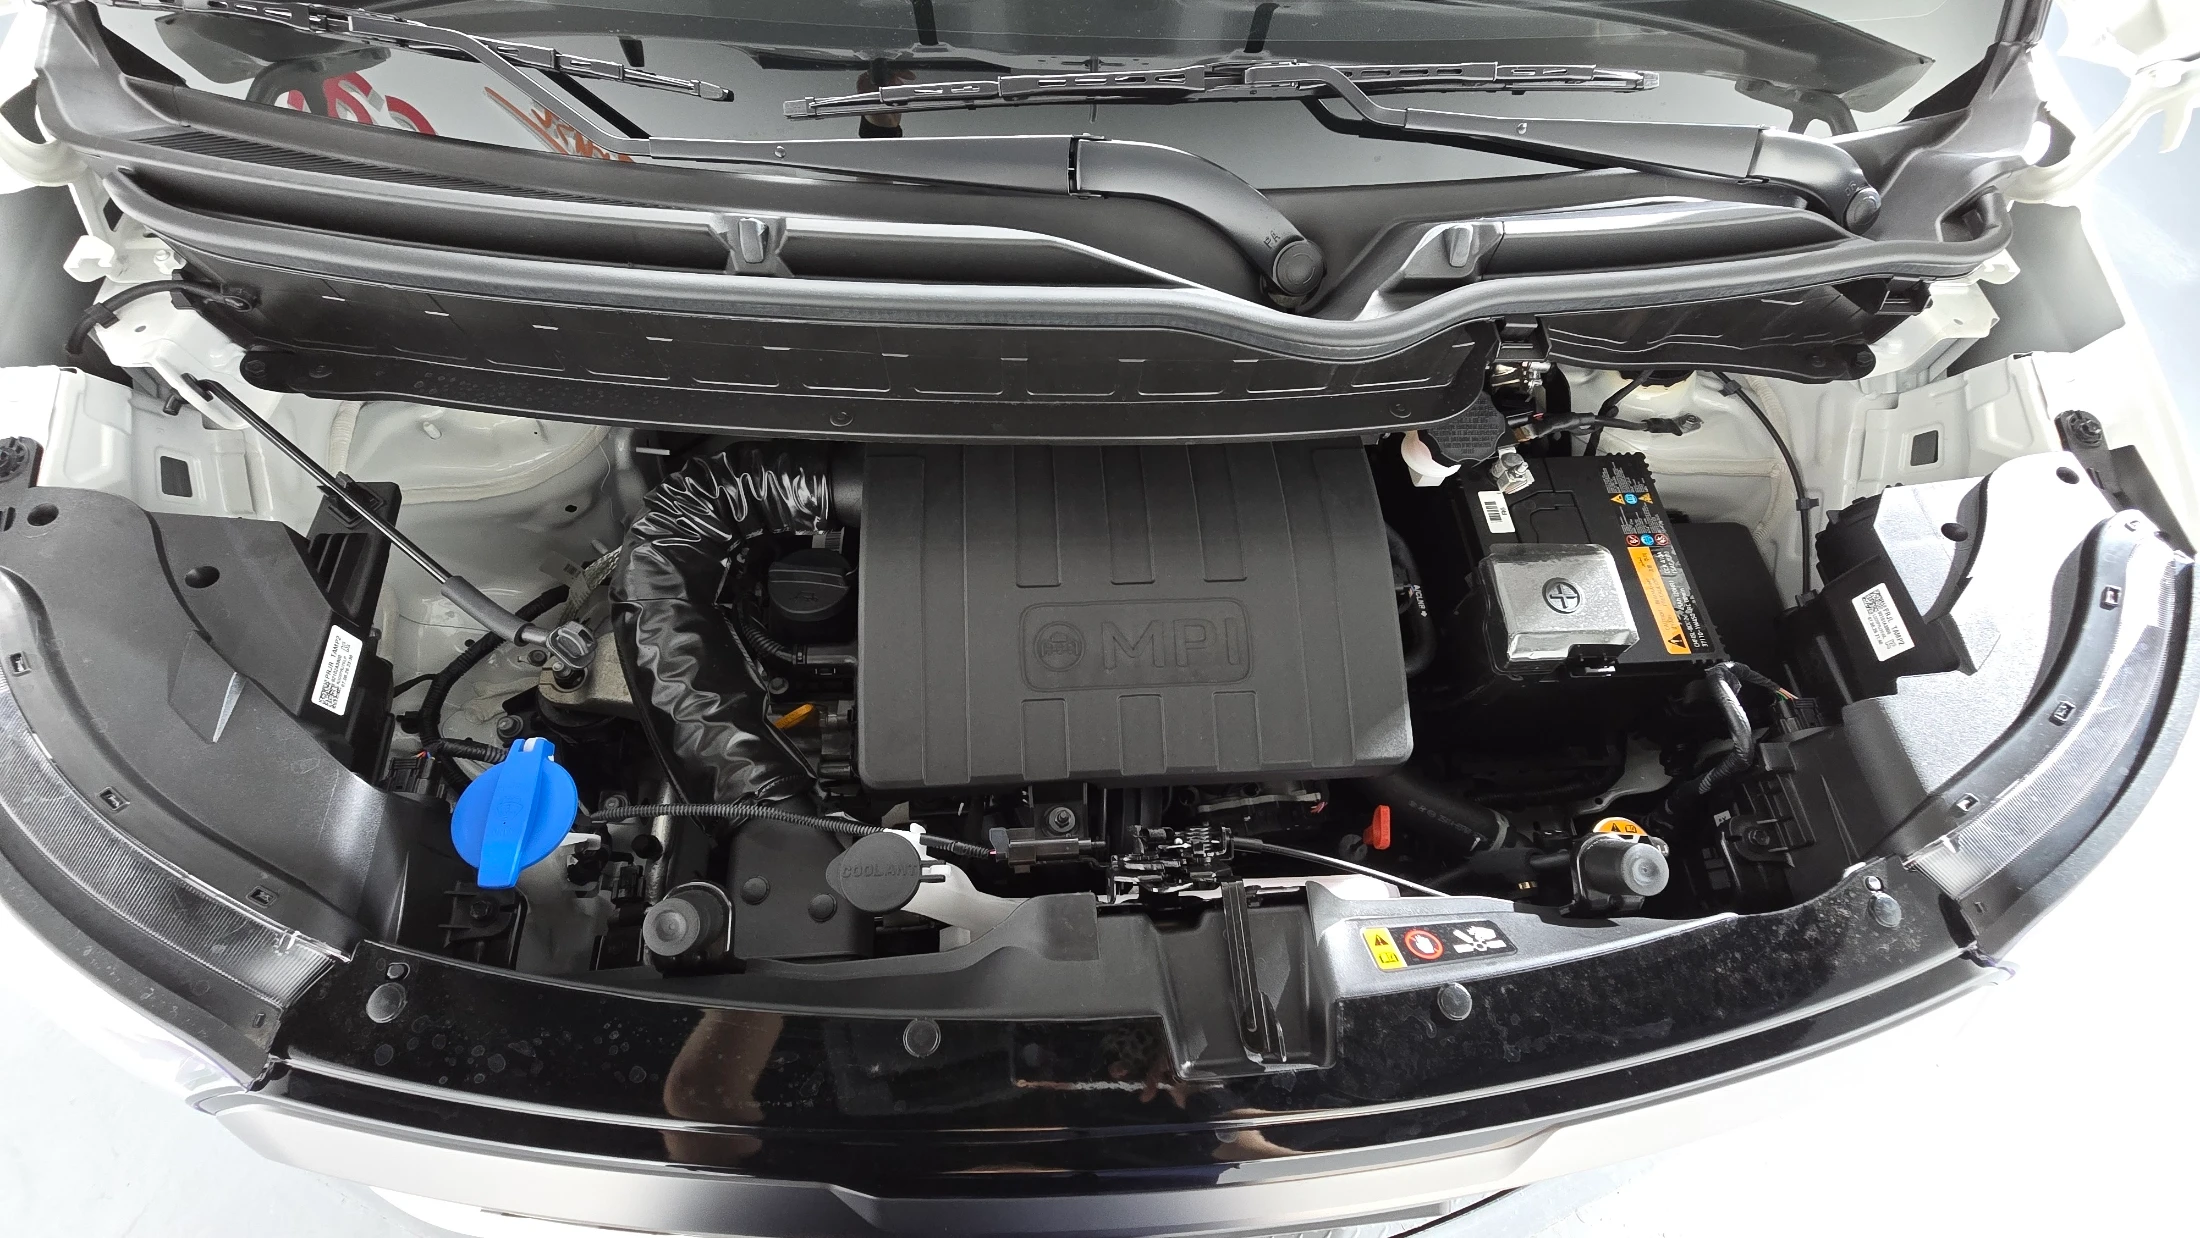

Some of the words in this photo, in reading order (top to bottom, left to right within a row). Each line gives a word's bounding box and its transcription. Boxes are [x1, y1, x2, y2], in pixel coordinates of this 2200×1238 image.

[1263, 230, 1281, 249] PA
[1101, 617, 1241, 671] MPI
[842, 863, 918, 879] COOLANT
